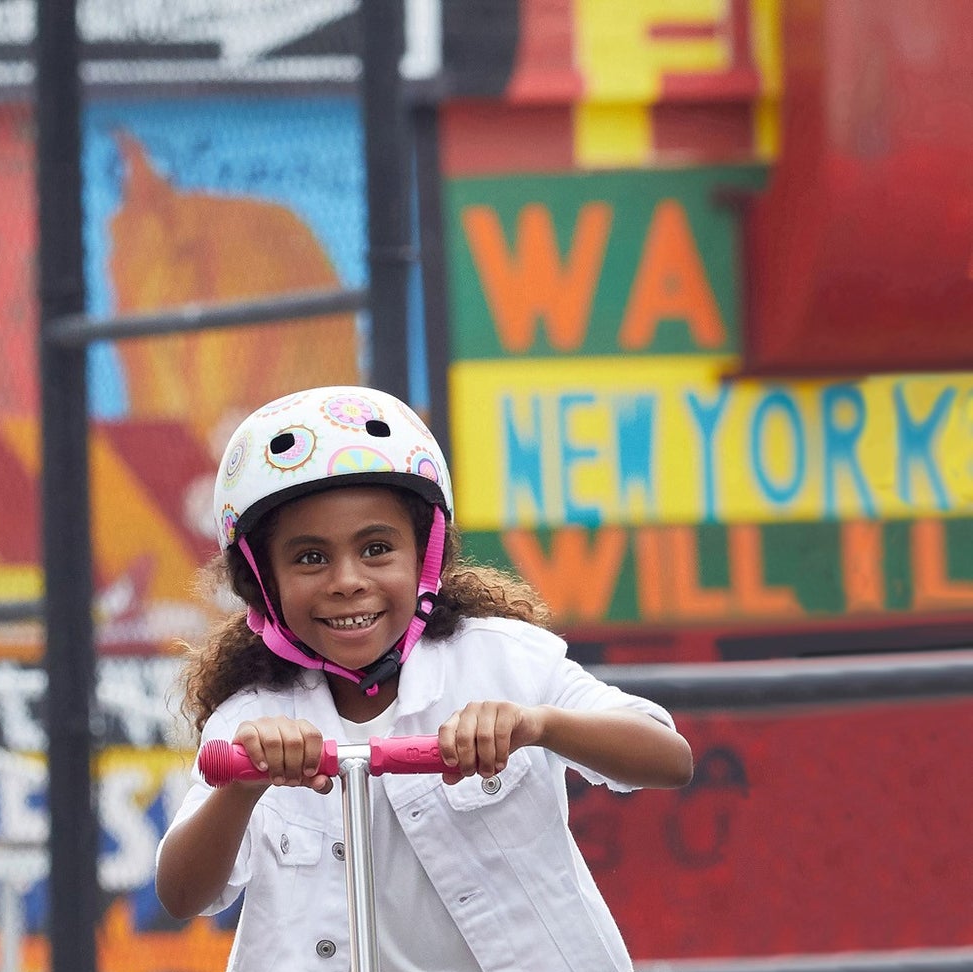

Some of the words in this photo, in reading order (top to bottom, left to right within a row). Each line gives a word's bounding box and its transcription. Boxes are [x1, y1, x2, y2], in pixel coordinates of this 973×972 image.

[462, 200, 727, 352] WA
[501, 393, 661, 528] NEW
[686, 382, 973, 520] YORK
